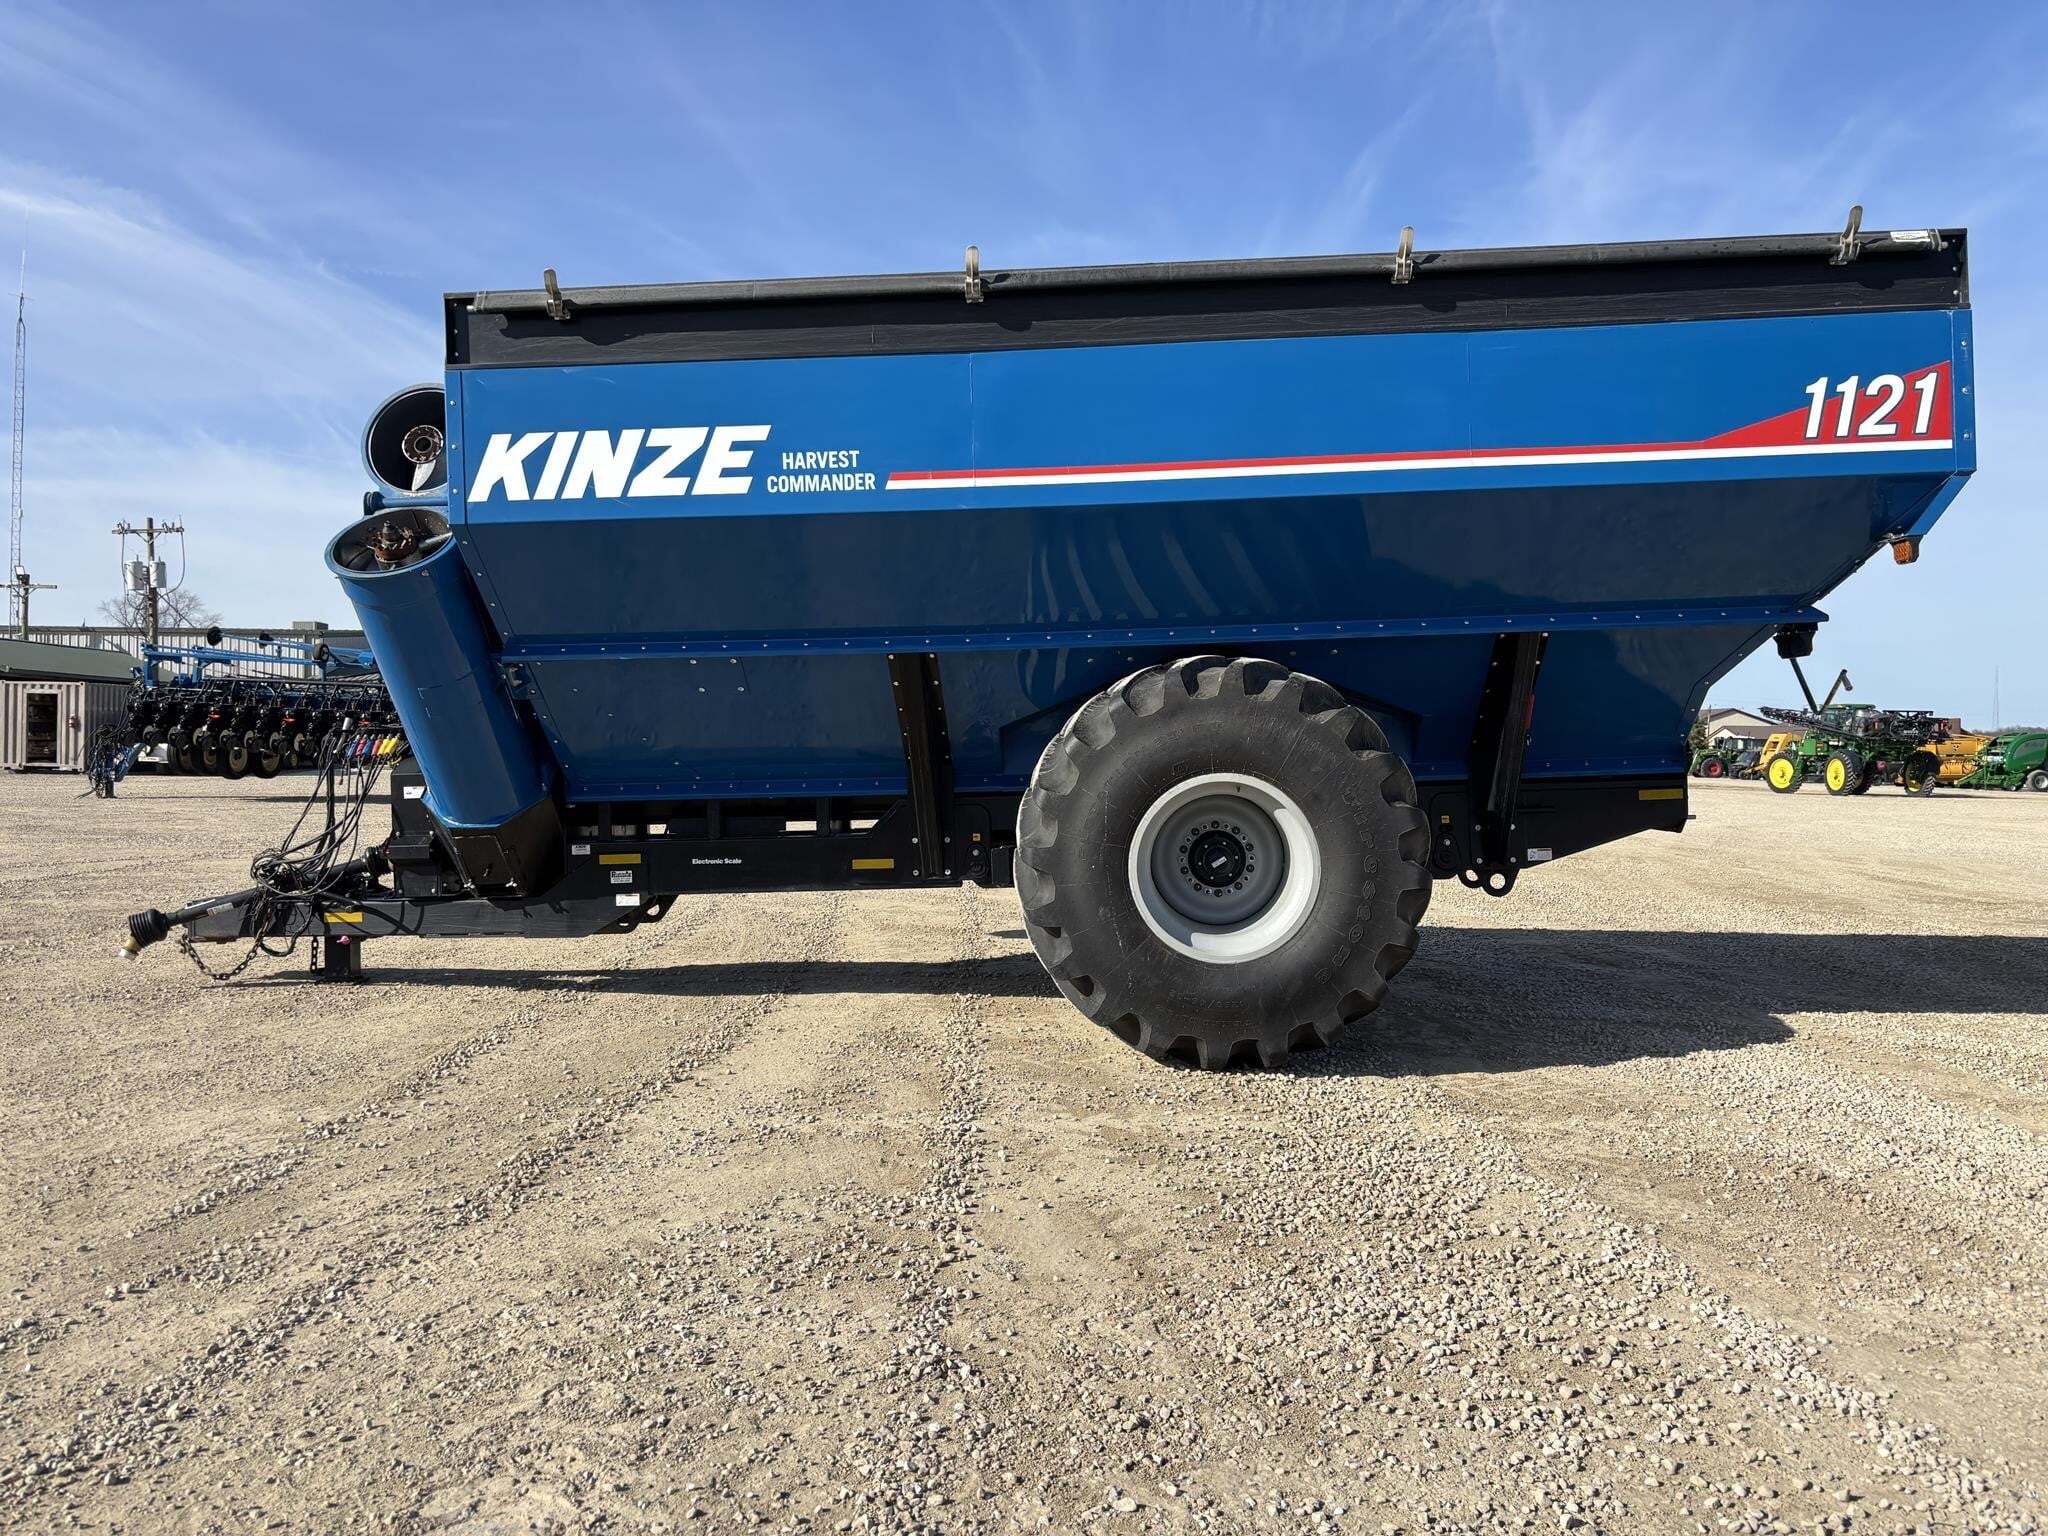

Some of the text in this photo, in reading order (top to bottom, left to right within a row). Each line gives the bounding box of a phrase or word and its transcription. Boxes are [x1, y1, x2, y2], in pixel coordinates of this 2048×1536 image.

[1804, 372, 1938, 438] 1121
[467, 424, 772, 503] KINZE
[782, 450, 860, 470] HARVEST
[767, 472, 876, 493] COMMANDER
[724, 857, 742, 865] Scale
